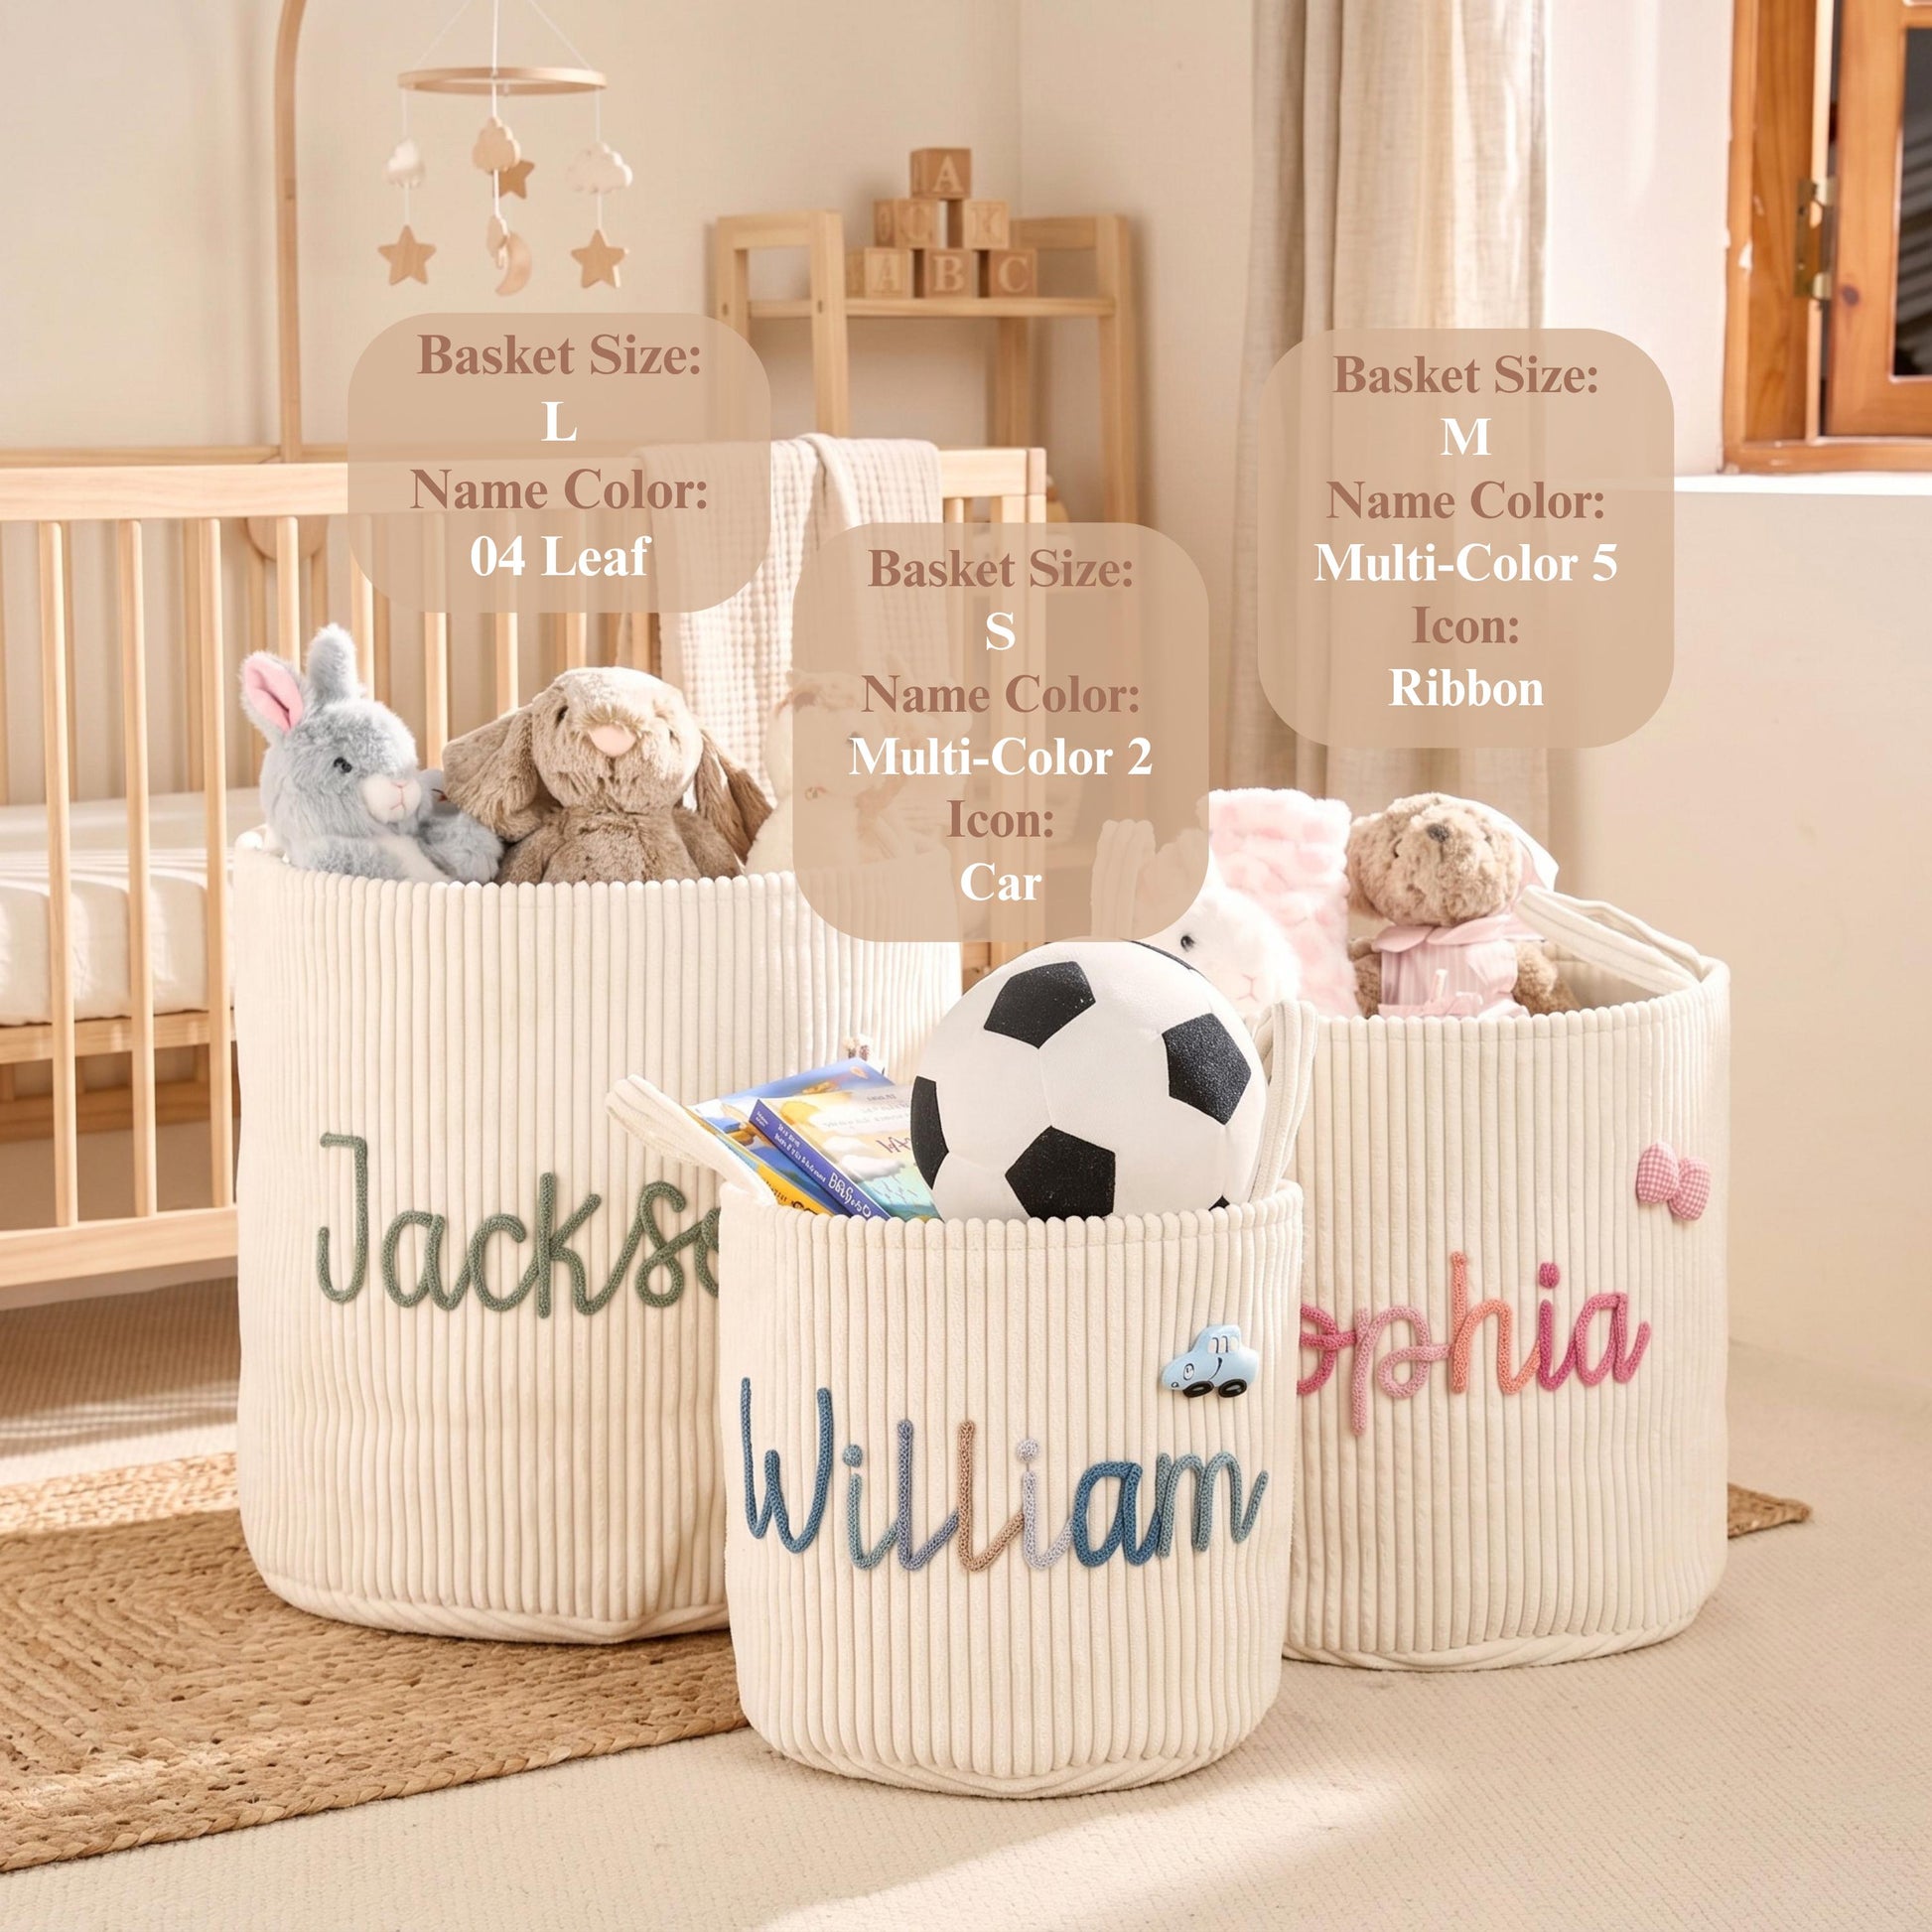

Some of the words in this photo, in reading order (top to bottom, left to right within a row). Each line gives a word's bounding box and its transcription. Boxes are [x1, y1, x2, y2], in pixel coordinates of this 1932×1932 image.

[932, 155, 964, 194] A
[932, 255, 965, 293] B
[997, 256, 1030, 294] C
[741, 1376, 1269, 1573] William
